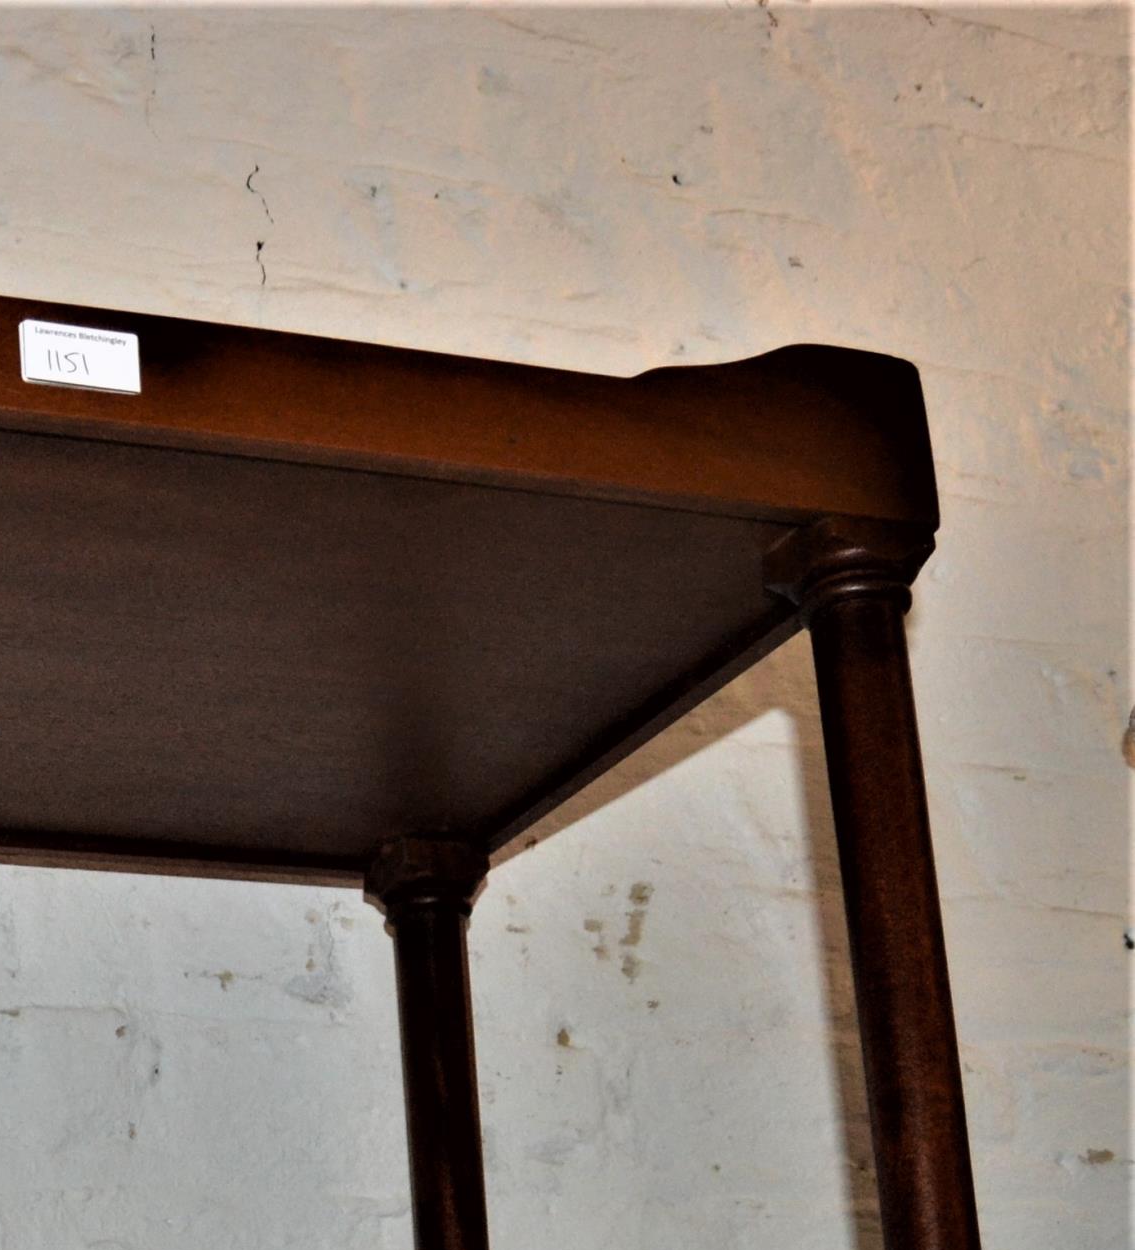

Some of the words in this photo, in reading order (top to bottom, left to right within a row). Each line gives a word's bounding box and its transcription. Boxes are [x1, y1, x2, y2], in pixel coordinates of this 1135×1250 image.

[34, 326, 77, 339] Lawrences
[79, 332, 126, 346] Bletchingley
[47, 349, 89, 375] 1151
